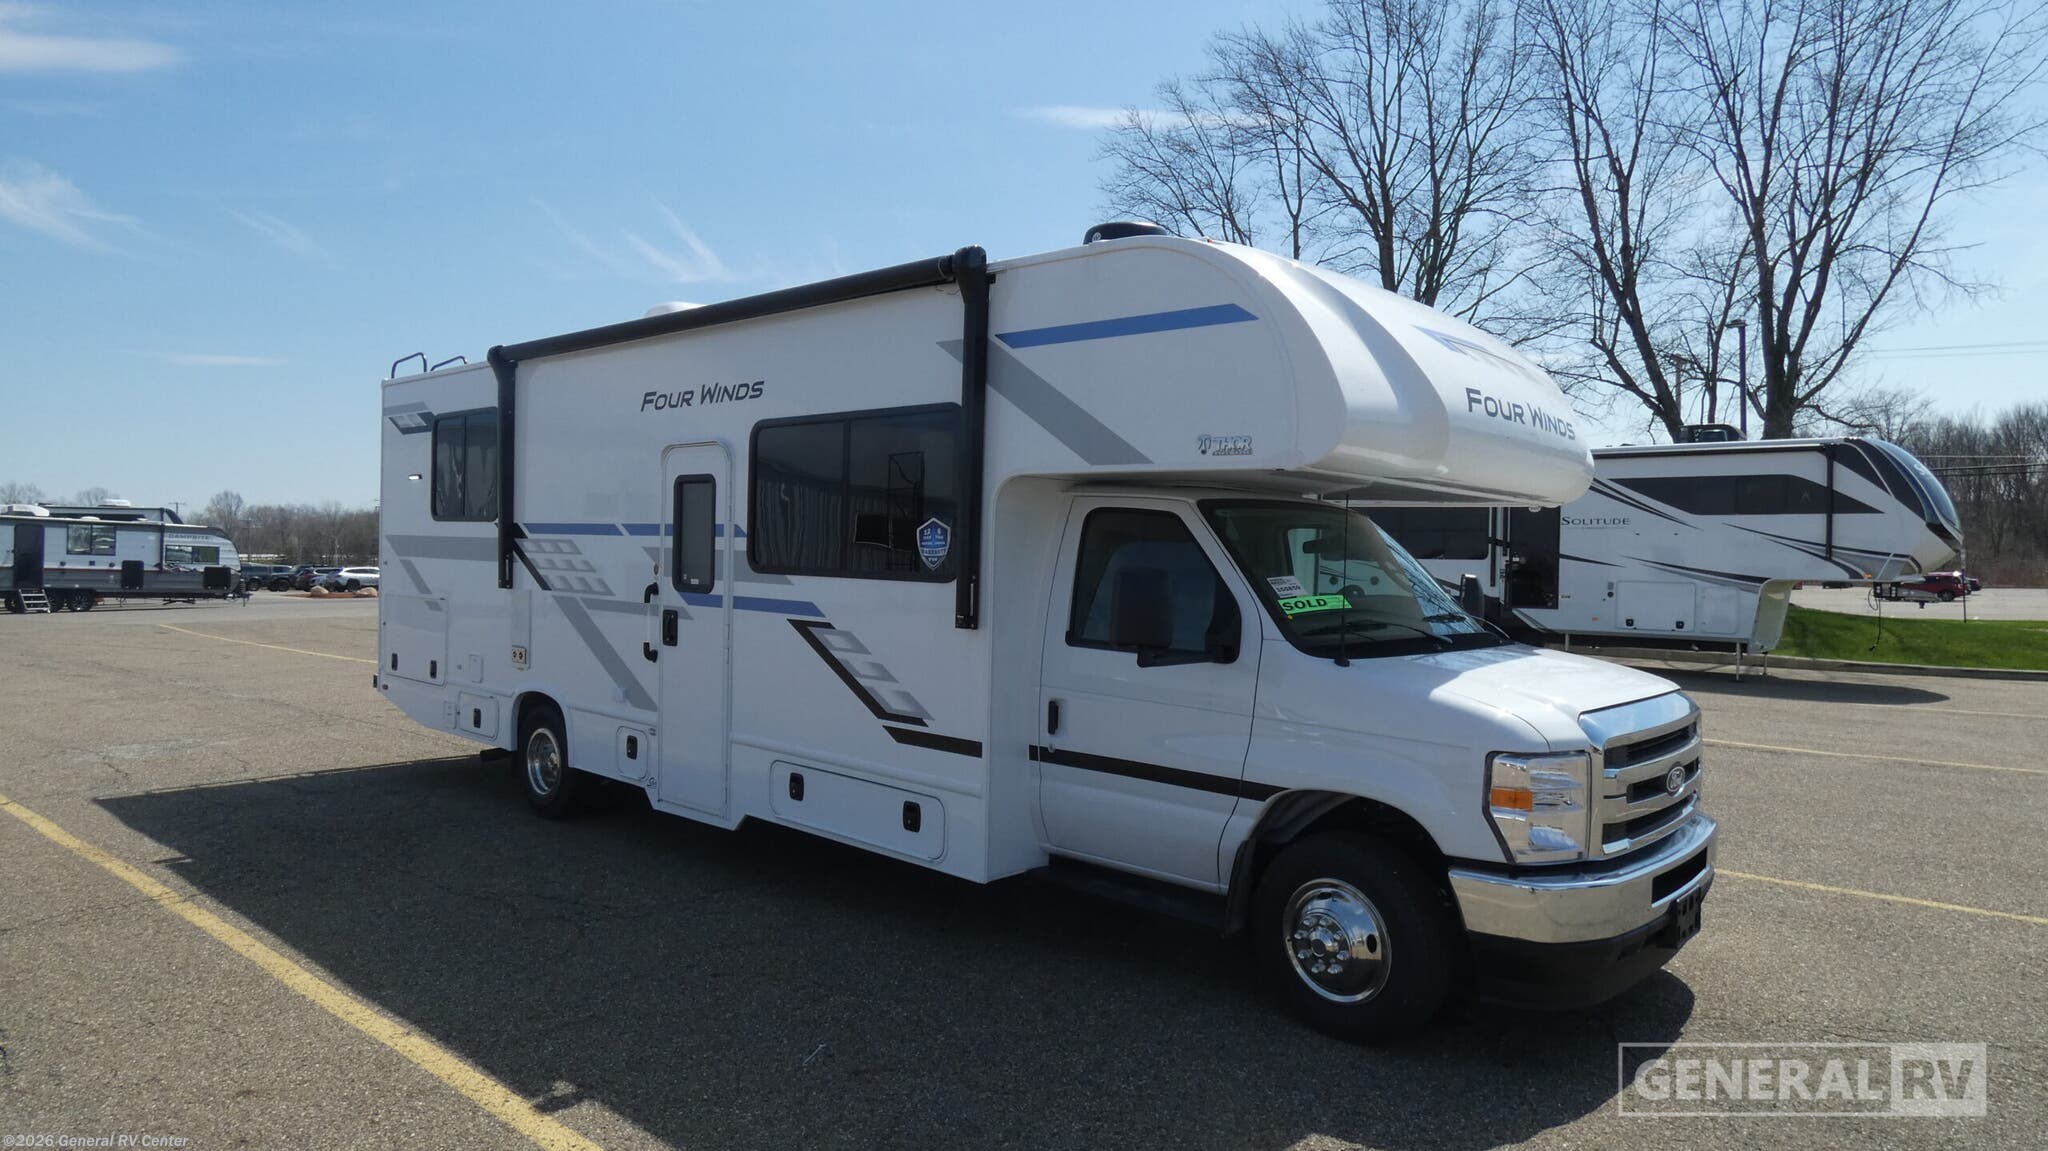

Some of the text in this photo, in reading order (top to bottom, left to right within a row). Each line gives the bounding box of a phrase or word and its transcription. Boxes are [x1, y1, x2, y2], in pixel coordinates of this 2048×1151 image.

[641, 381, 764, 412] FOUR WINDS
[1465, 387, 1576, 440] FOUR WINDS
[1561, 516, 1631, 526] SOLITUDE
[1282, 598, 1327, 611] SOLD
